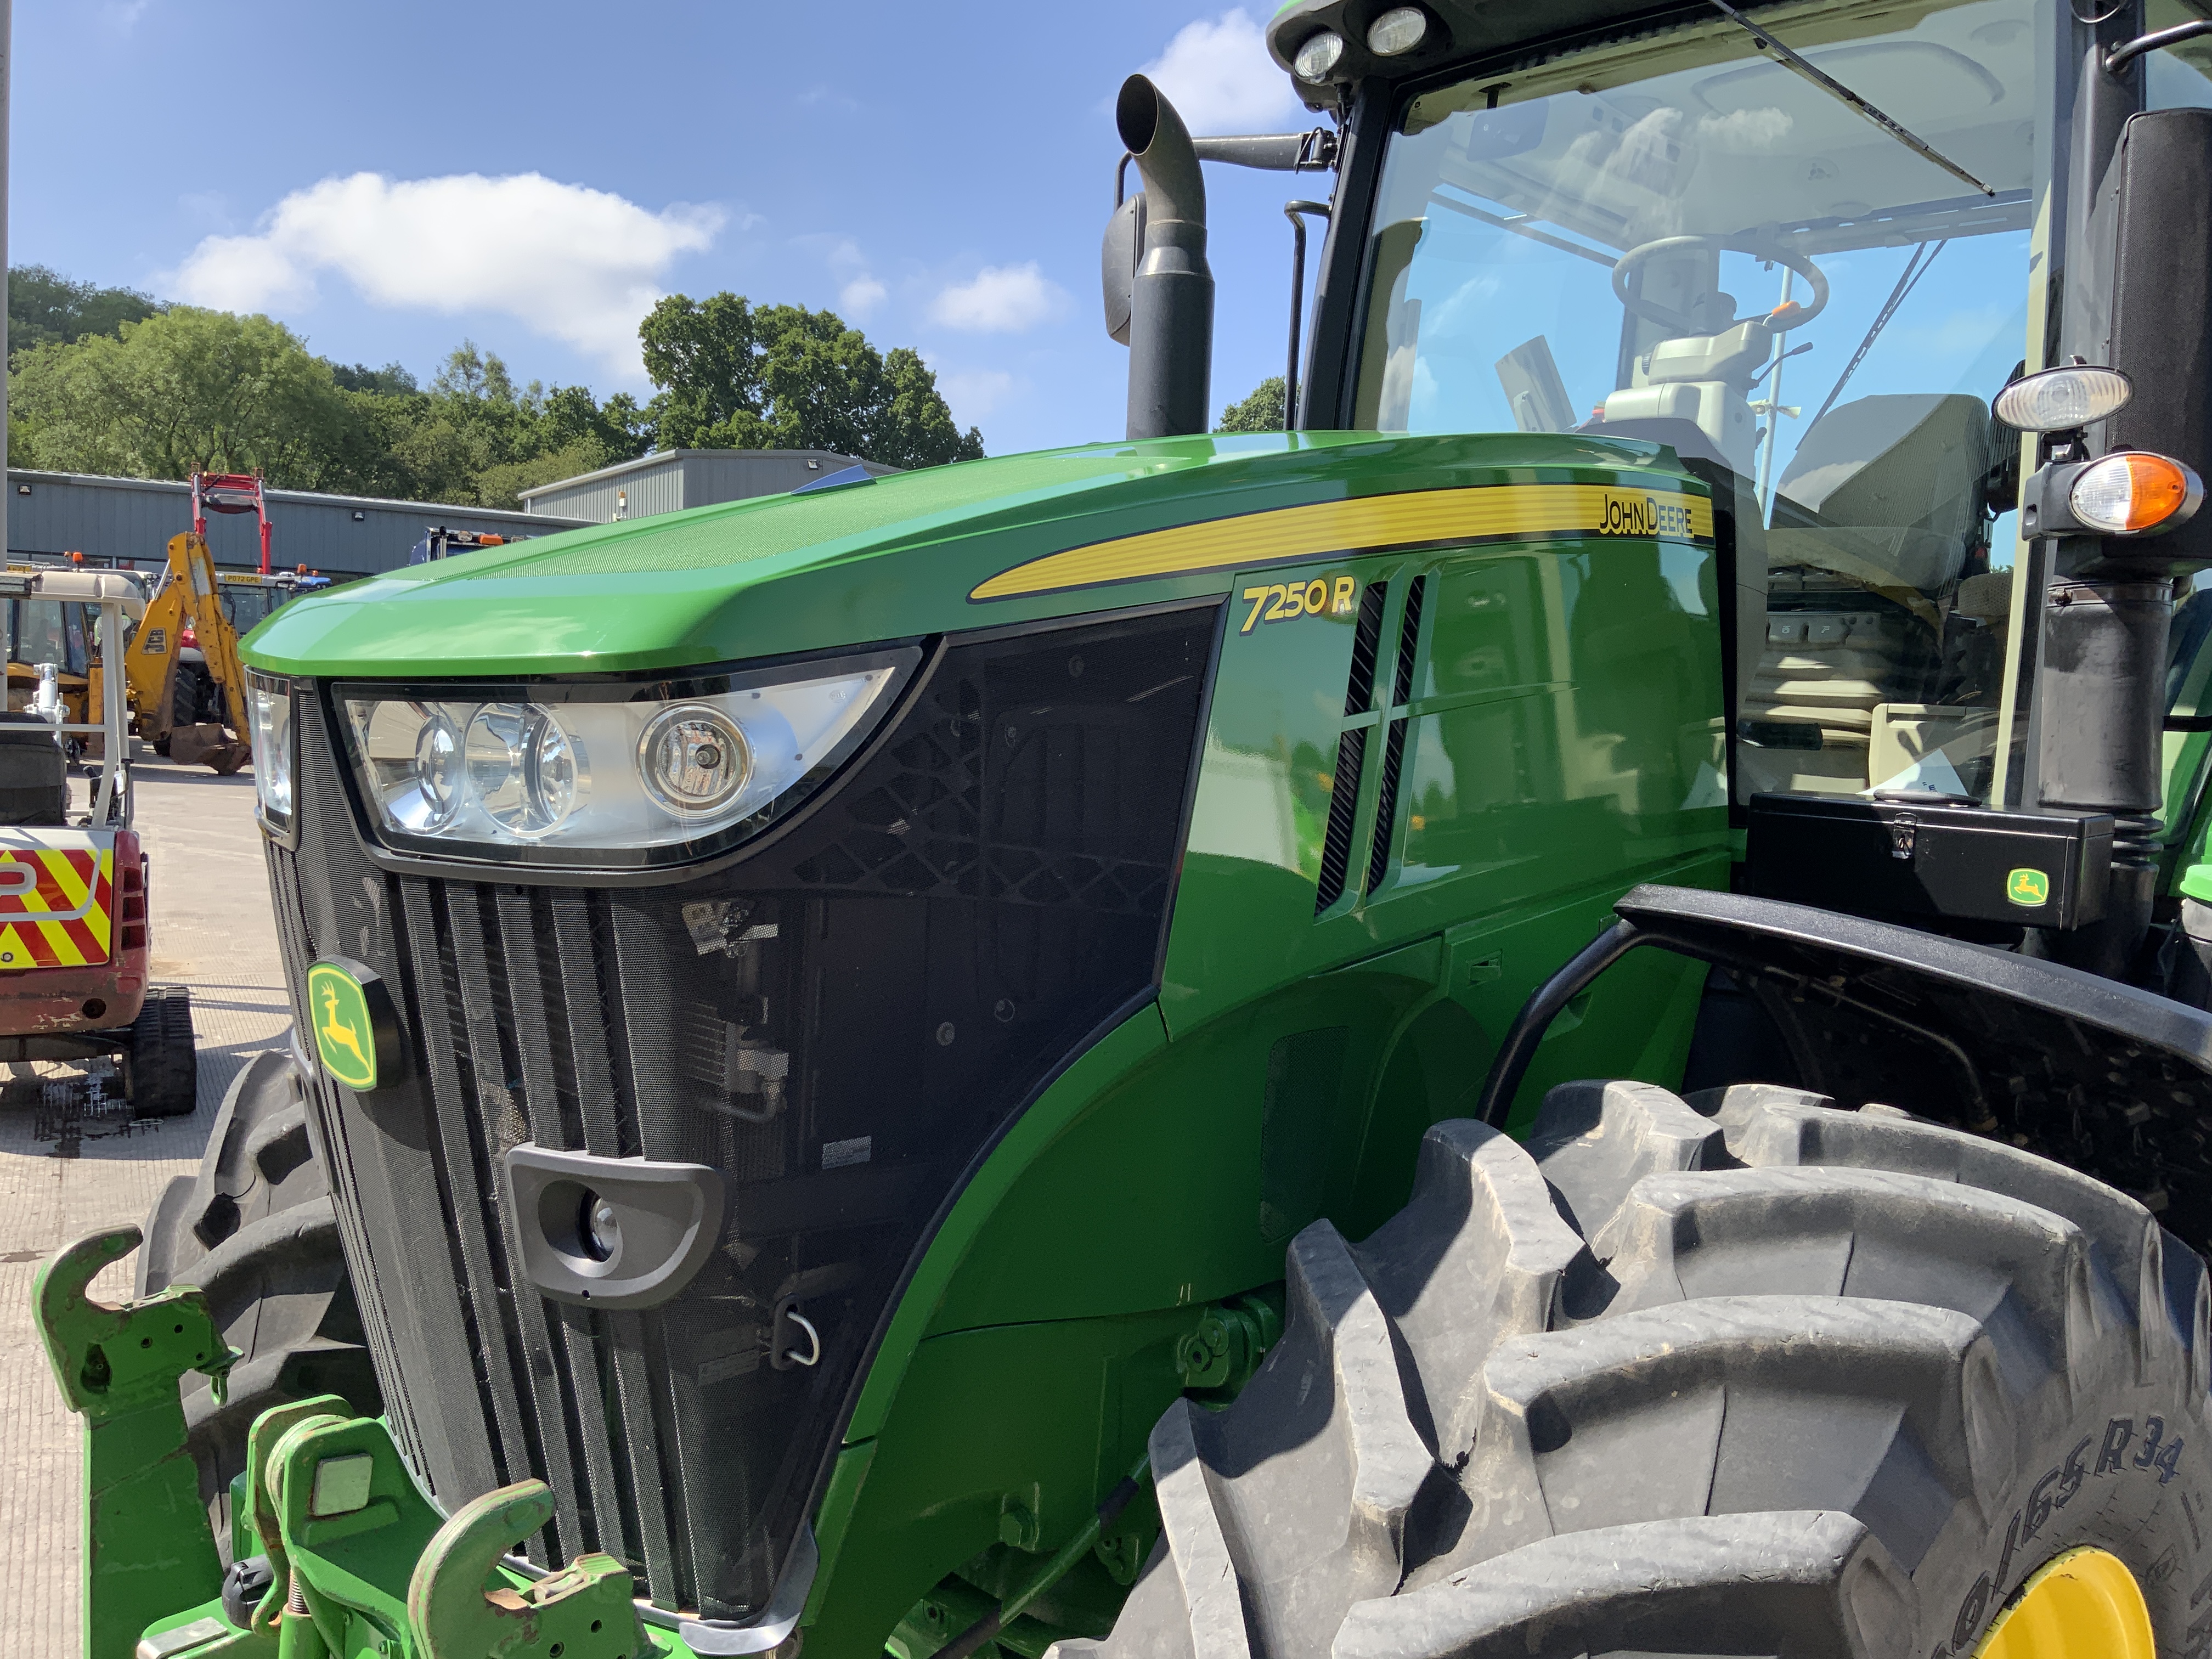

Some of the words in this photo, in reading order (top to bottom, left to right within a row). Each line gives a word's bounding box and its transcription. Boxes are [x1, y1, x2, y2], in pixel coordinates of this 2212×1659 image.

[1599, 493, 1645, 531] JOHN
[1646, 496, 1693, 535] DEERE
[144, 629, 165, 652] JCB
